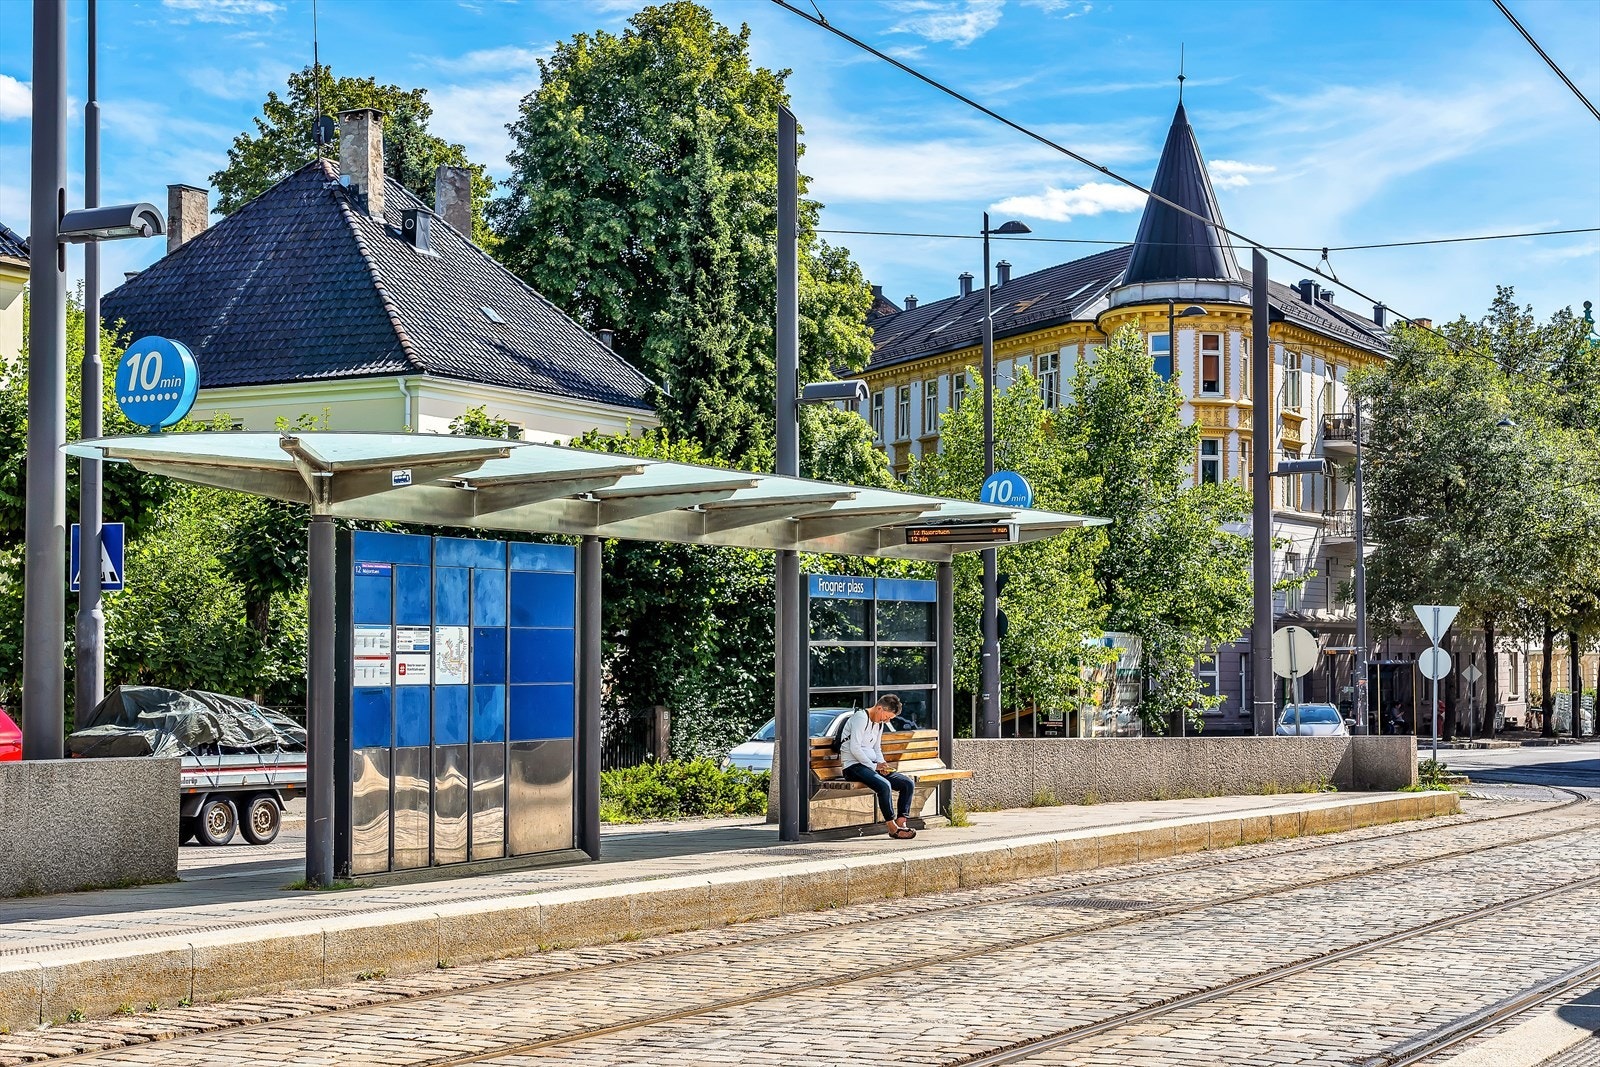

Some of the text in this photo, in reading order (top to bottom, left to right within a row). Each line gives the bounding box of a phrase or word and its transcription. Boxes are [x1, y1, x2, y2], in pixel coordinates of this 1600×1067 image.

[126, 351, 182, 391] 10 min
[987, 479, 1026, 503] 10 min
[355, 565, 362, 574] 12
[818, 578, 864, 596] Frogner plass
